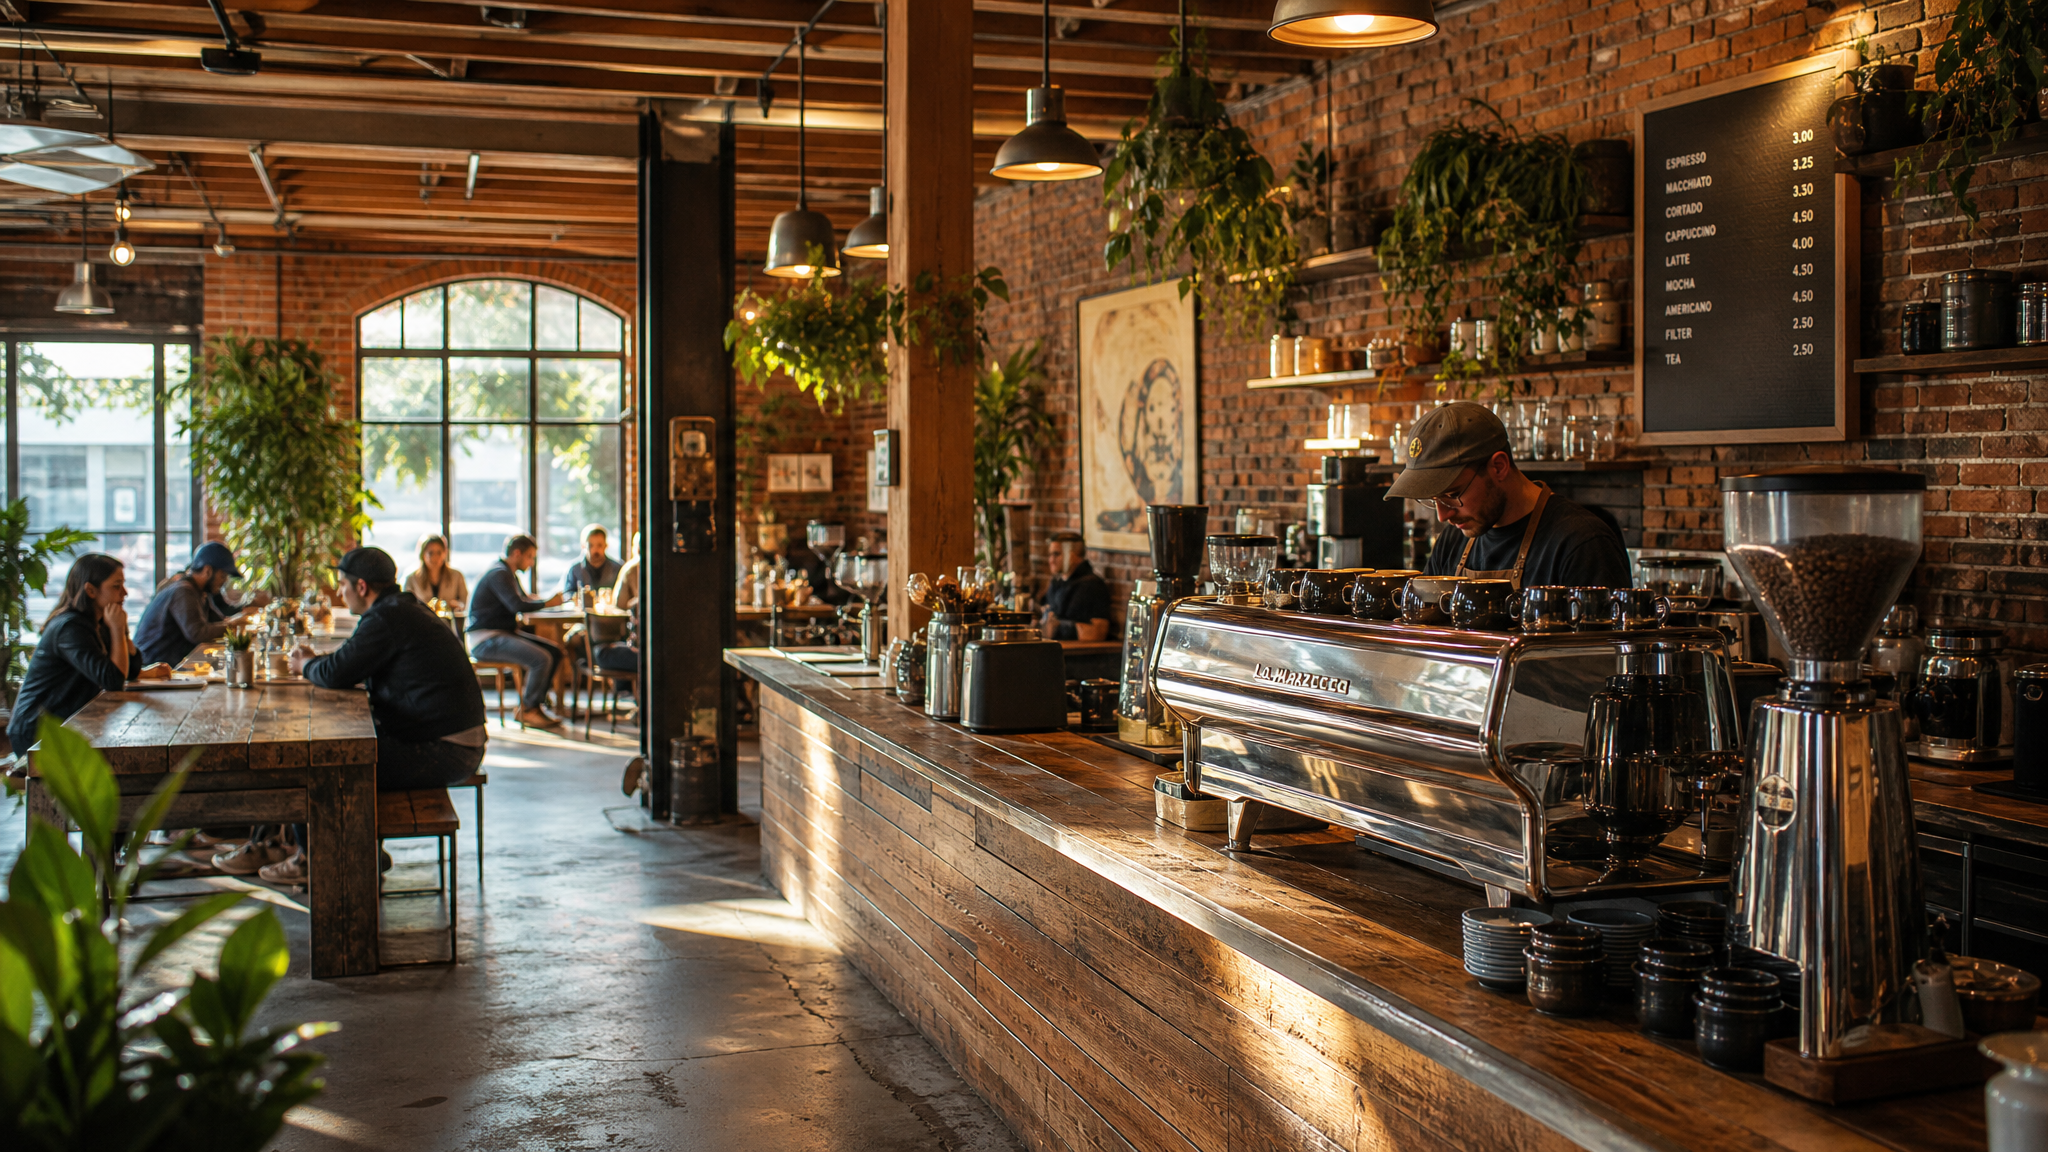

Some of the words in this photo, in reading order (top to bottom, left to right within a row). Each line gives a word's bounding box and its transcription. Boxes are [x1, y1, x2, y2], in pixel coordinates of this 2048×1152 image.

[1666, 152, 1706, 170] ESPRESSO
[1793, 129, 1813, 144] 3.00
[1666, 175, 1712, 193] MACCHIATO
[1793, 156, 1813, 170] 3.25
[1666, 202, 1702, 218] CORTADO
[1666, 224, 1716, 242] CAPPUCCINO
[1666, 253, 1690, 267] LATTE
[1792, 237, 1813, 249] 4.00
[1666, 278, 1695, 291] MOCHA
[1793, 263, 1813, 276] 4.50
[1665, 301, 1712, 315] AMERICANO
[1666, 328, 1692, 340] FILTER
[1793, 317, 1813, 329] 2.50
[1666, 354, 1681, 364] TEA
[1793, 344, 1813, 355] 2.50
